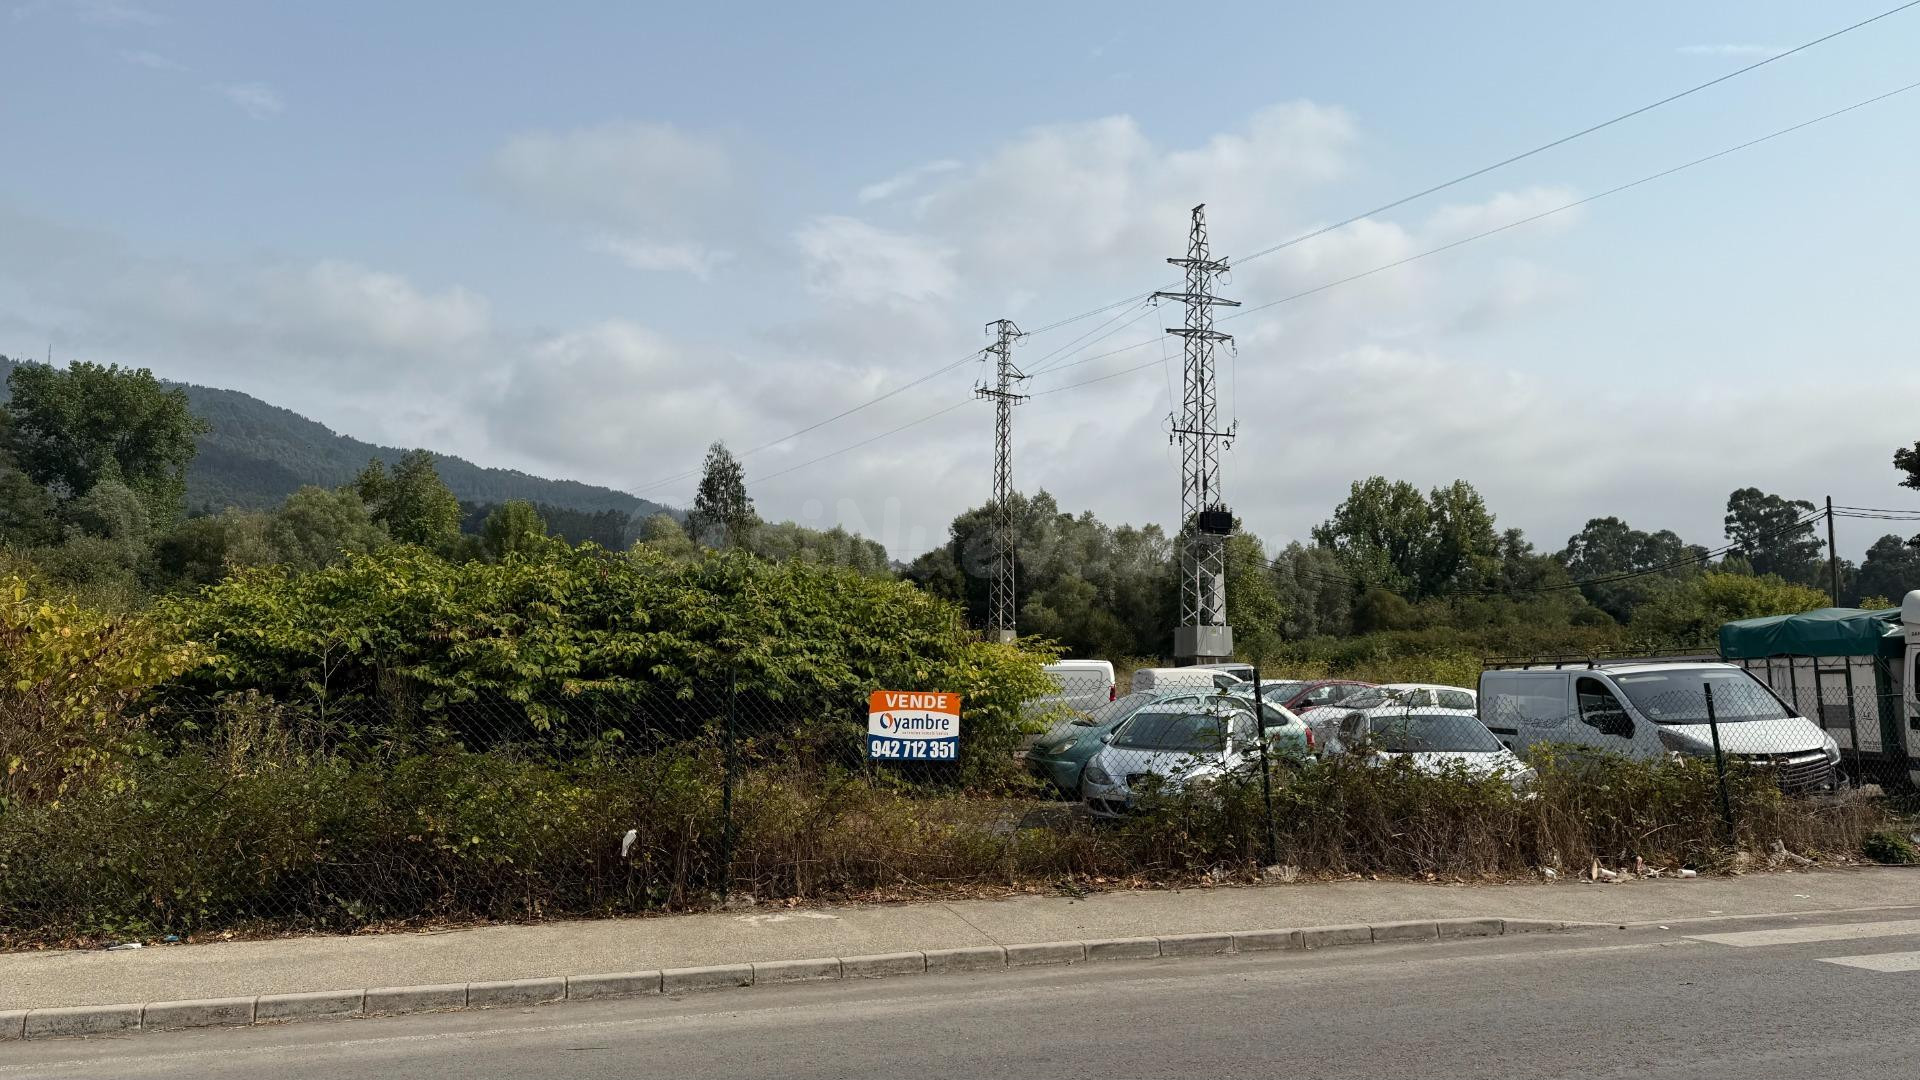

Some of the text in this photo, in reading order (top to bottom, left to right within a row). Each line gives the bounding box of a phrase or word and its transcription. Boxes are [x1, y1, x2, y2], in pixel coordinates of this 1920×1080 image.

[885, 693, 948, 709] VENDE
[880, 712, 950, 734] Oyambre
[871, 740, 955, 758] 942 712 351
